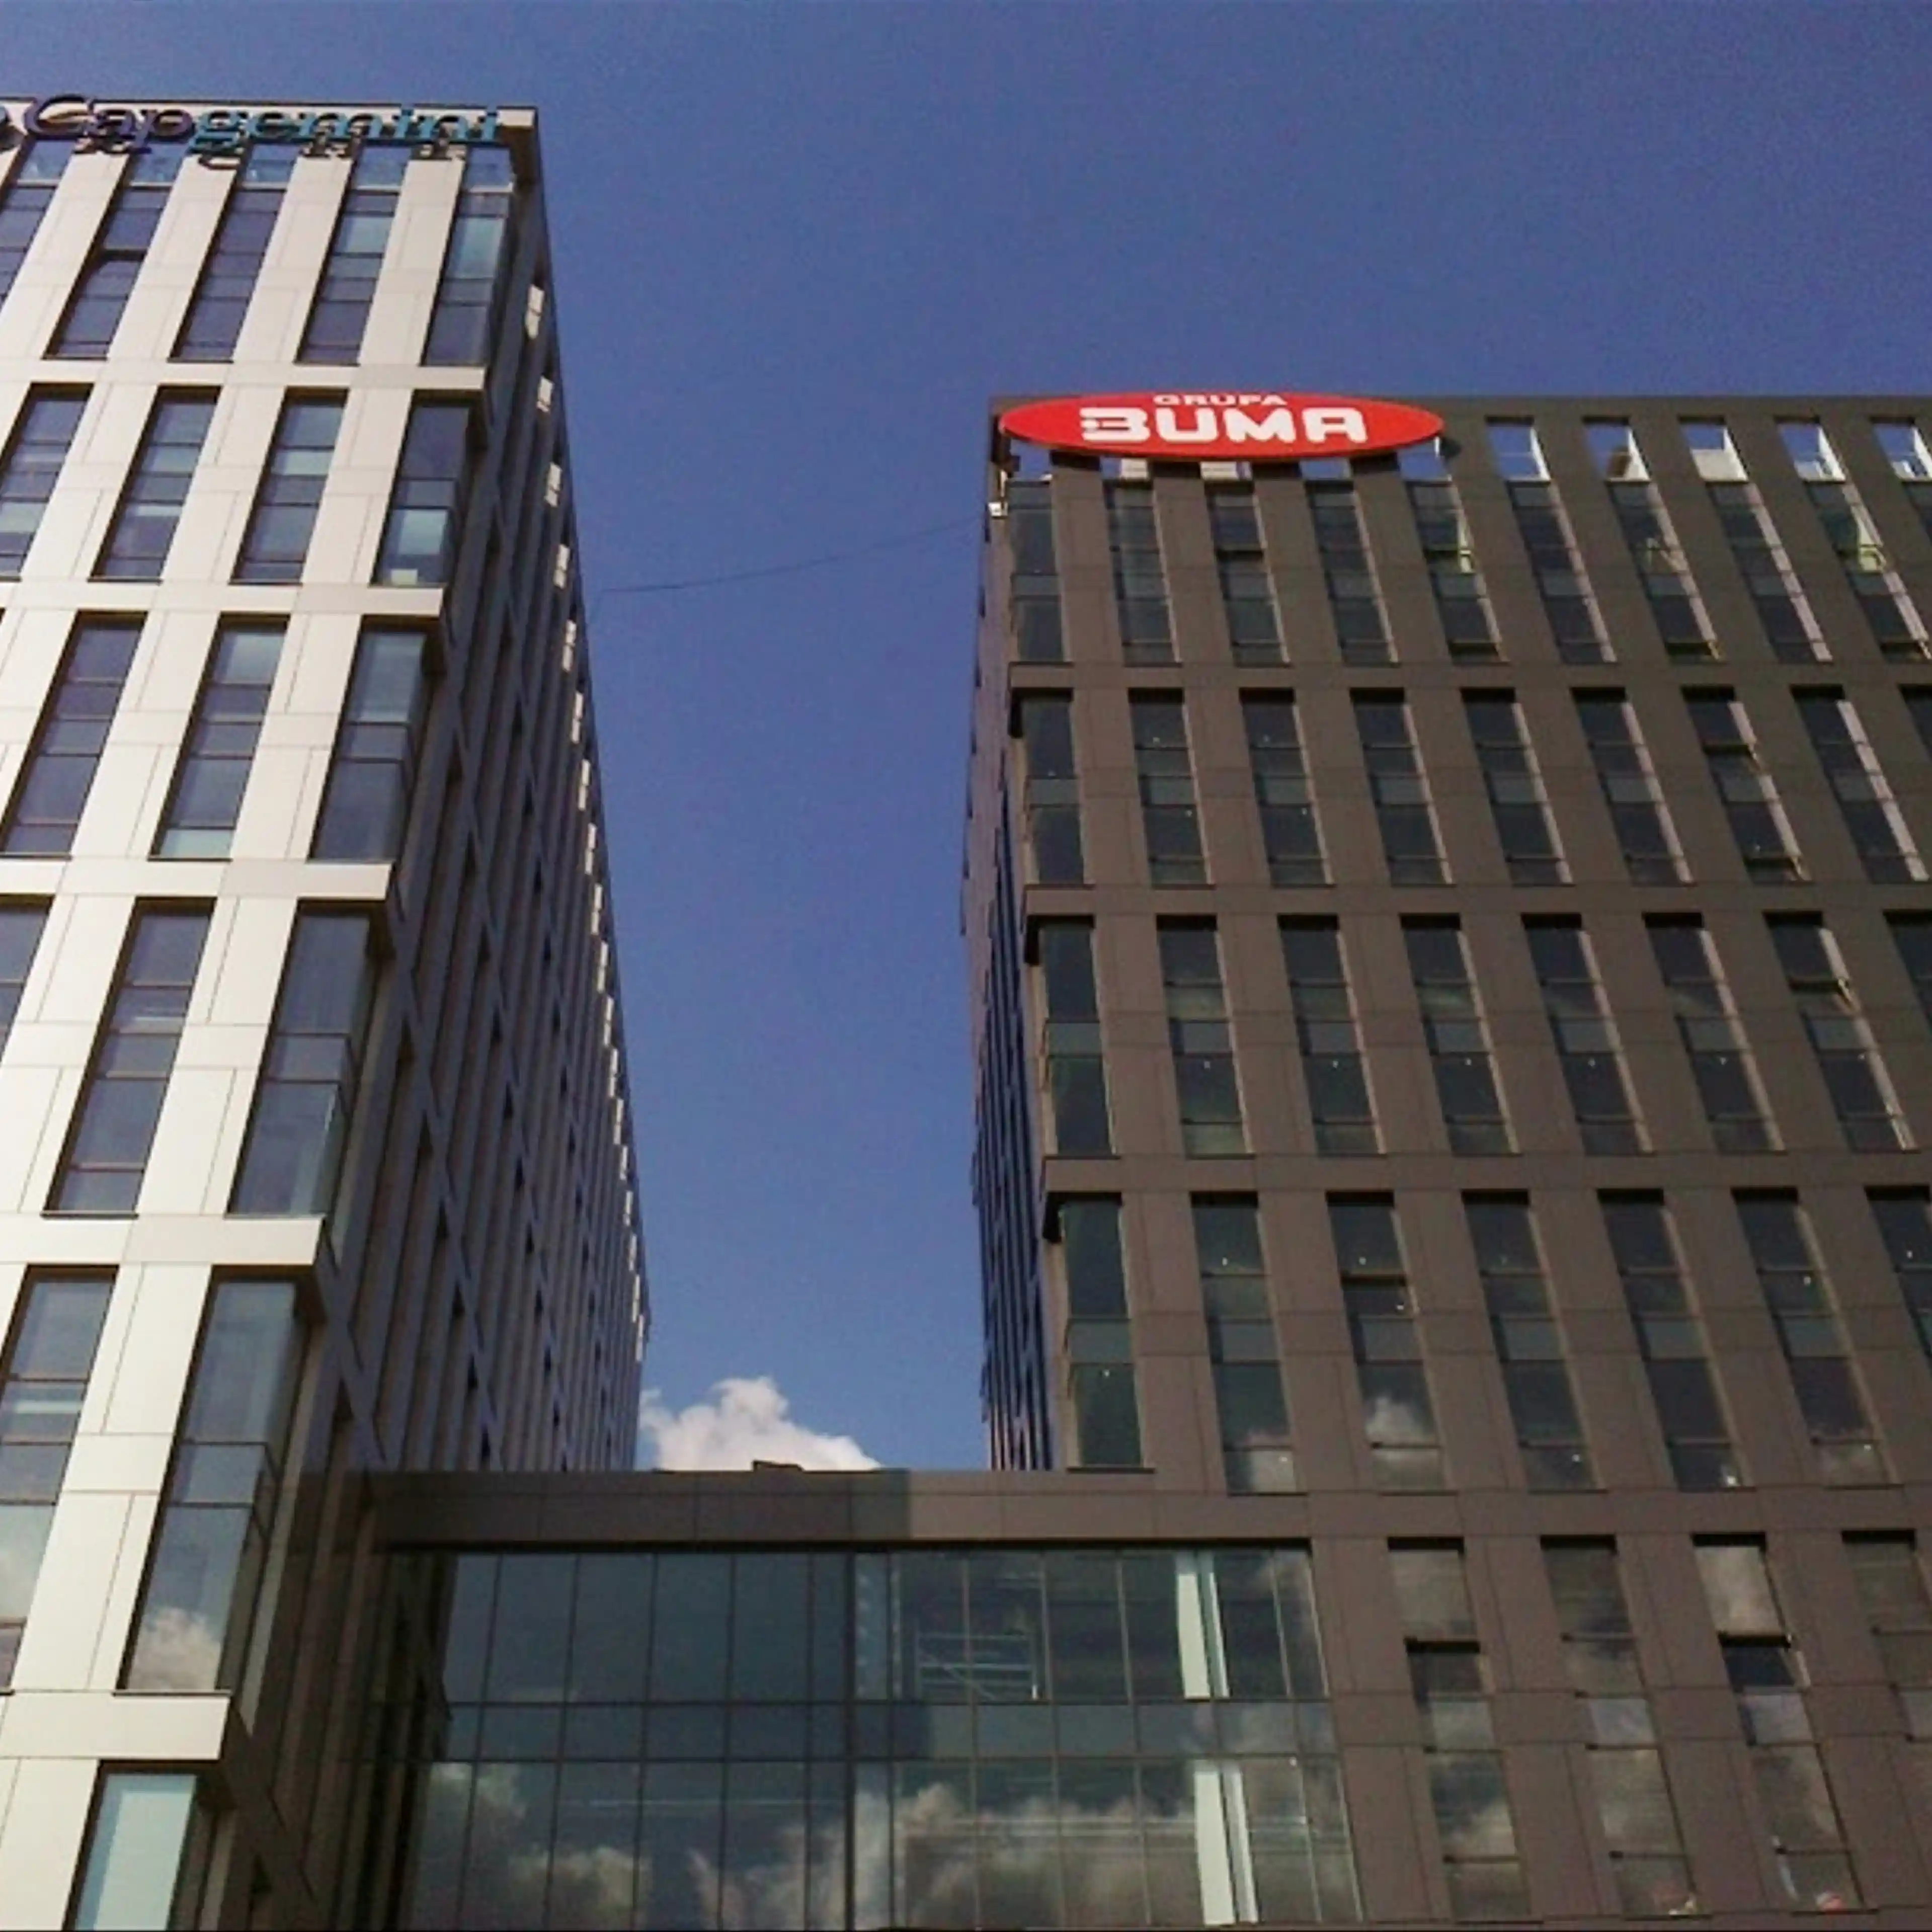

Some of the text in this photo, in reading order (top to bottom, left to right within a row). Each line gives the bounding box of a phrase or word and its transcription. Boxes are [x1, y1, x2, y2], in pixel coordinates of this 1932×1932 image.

[24, 94, 501, 157] Capgemini
[1153, 394, 1288, 406] GRUPA
[1079, 407, 1367, 443] BUMA
